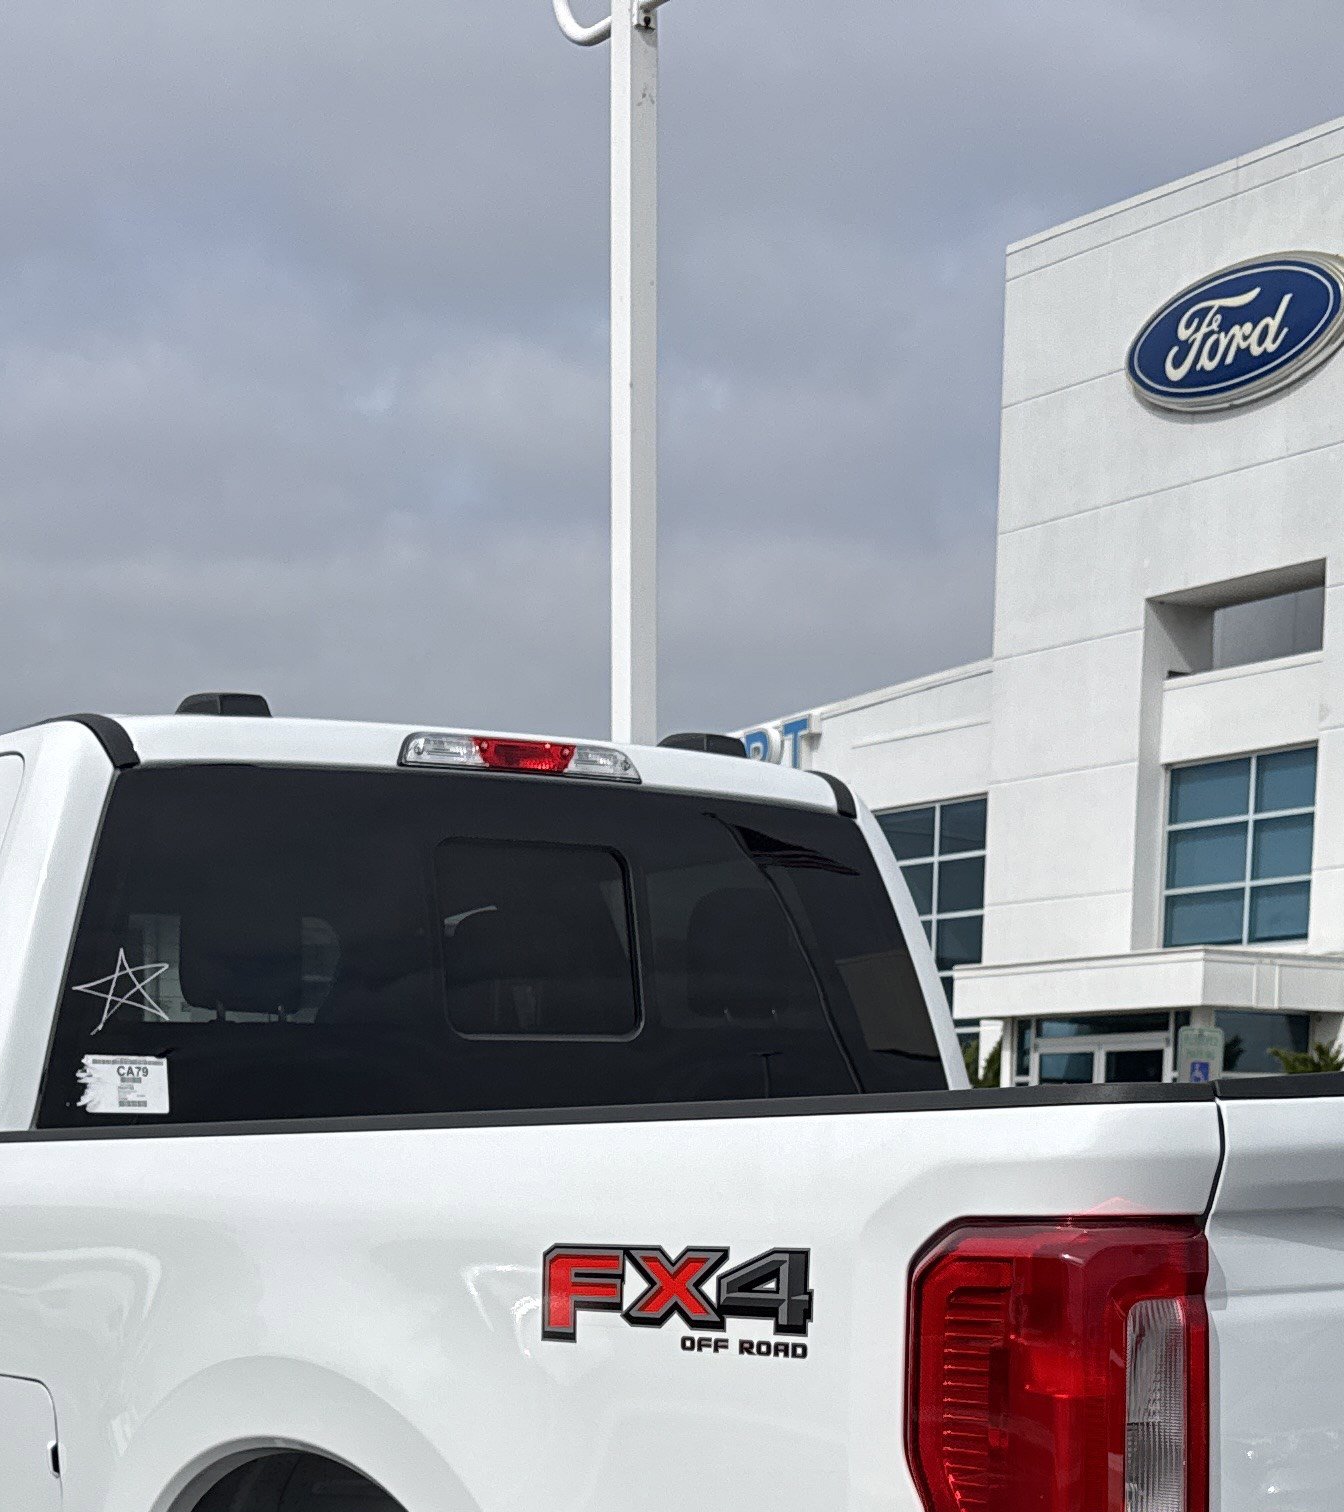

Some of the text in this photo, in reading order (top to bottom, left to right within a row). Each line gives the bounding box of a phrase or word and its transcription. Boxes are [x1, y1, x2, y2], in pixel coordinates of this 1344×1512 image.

[1164, 286, 1293, 382] Ford
[116, 1065, 149, 1077] CA79
[541, 1243, 814, 1343] FX4
[680, 1335, 808, 1359] OFF ROAD
